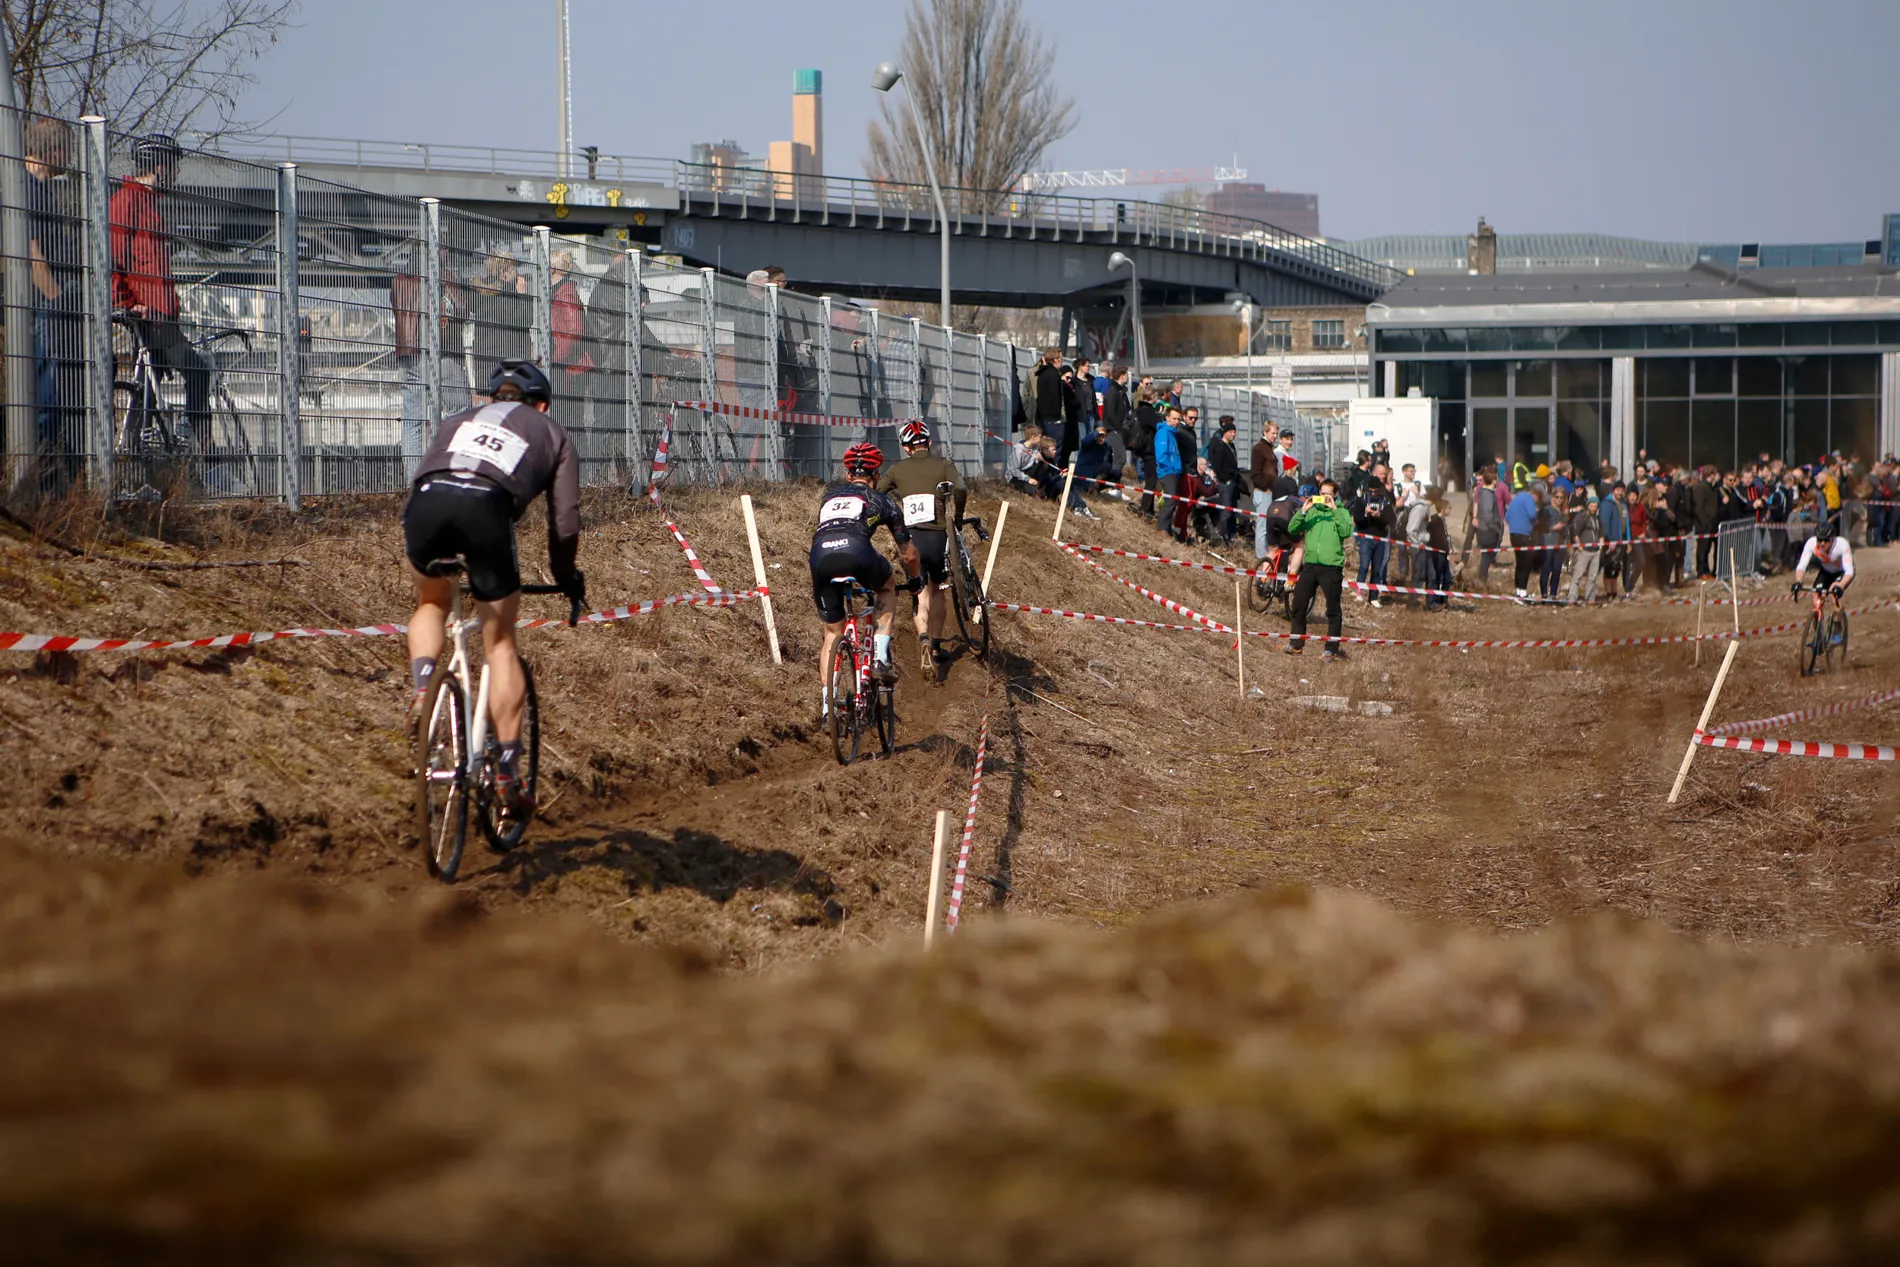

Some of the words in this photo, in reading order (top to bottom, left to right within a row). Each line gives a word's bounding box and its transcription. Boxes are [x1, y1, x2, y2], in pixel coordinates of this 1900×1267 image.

[473, 434, 505, 451] 45
[832, 502, 851, 511] 32
[911, 502, 925, 514] 34
